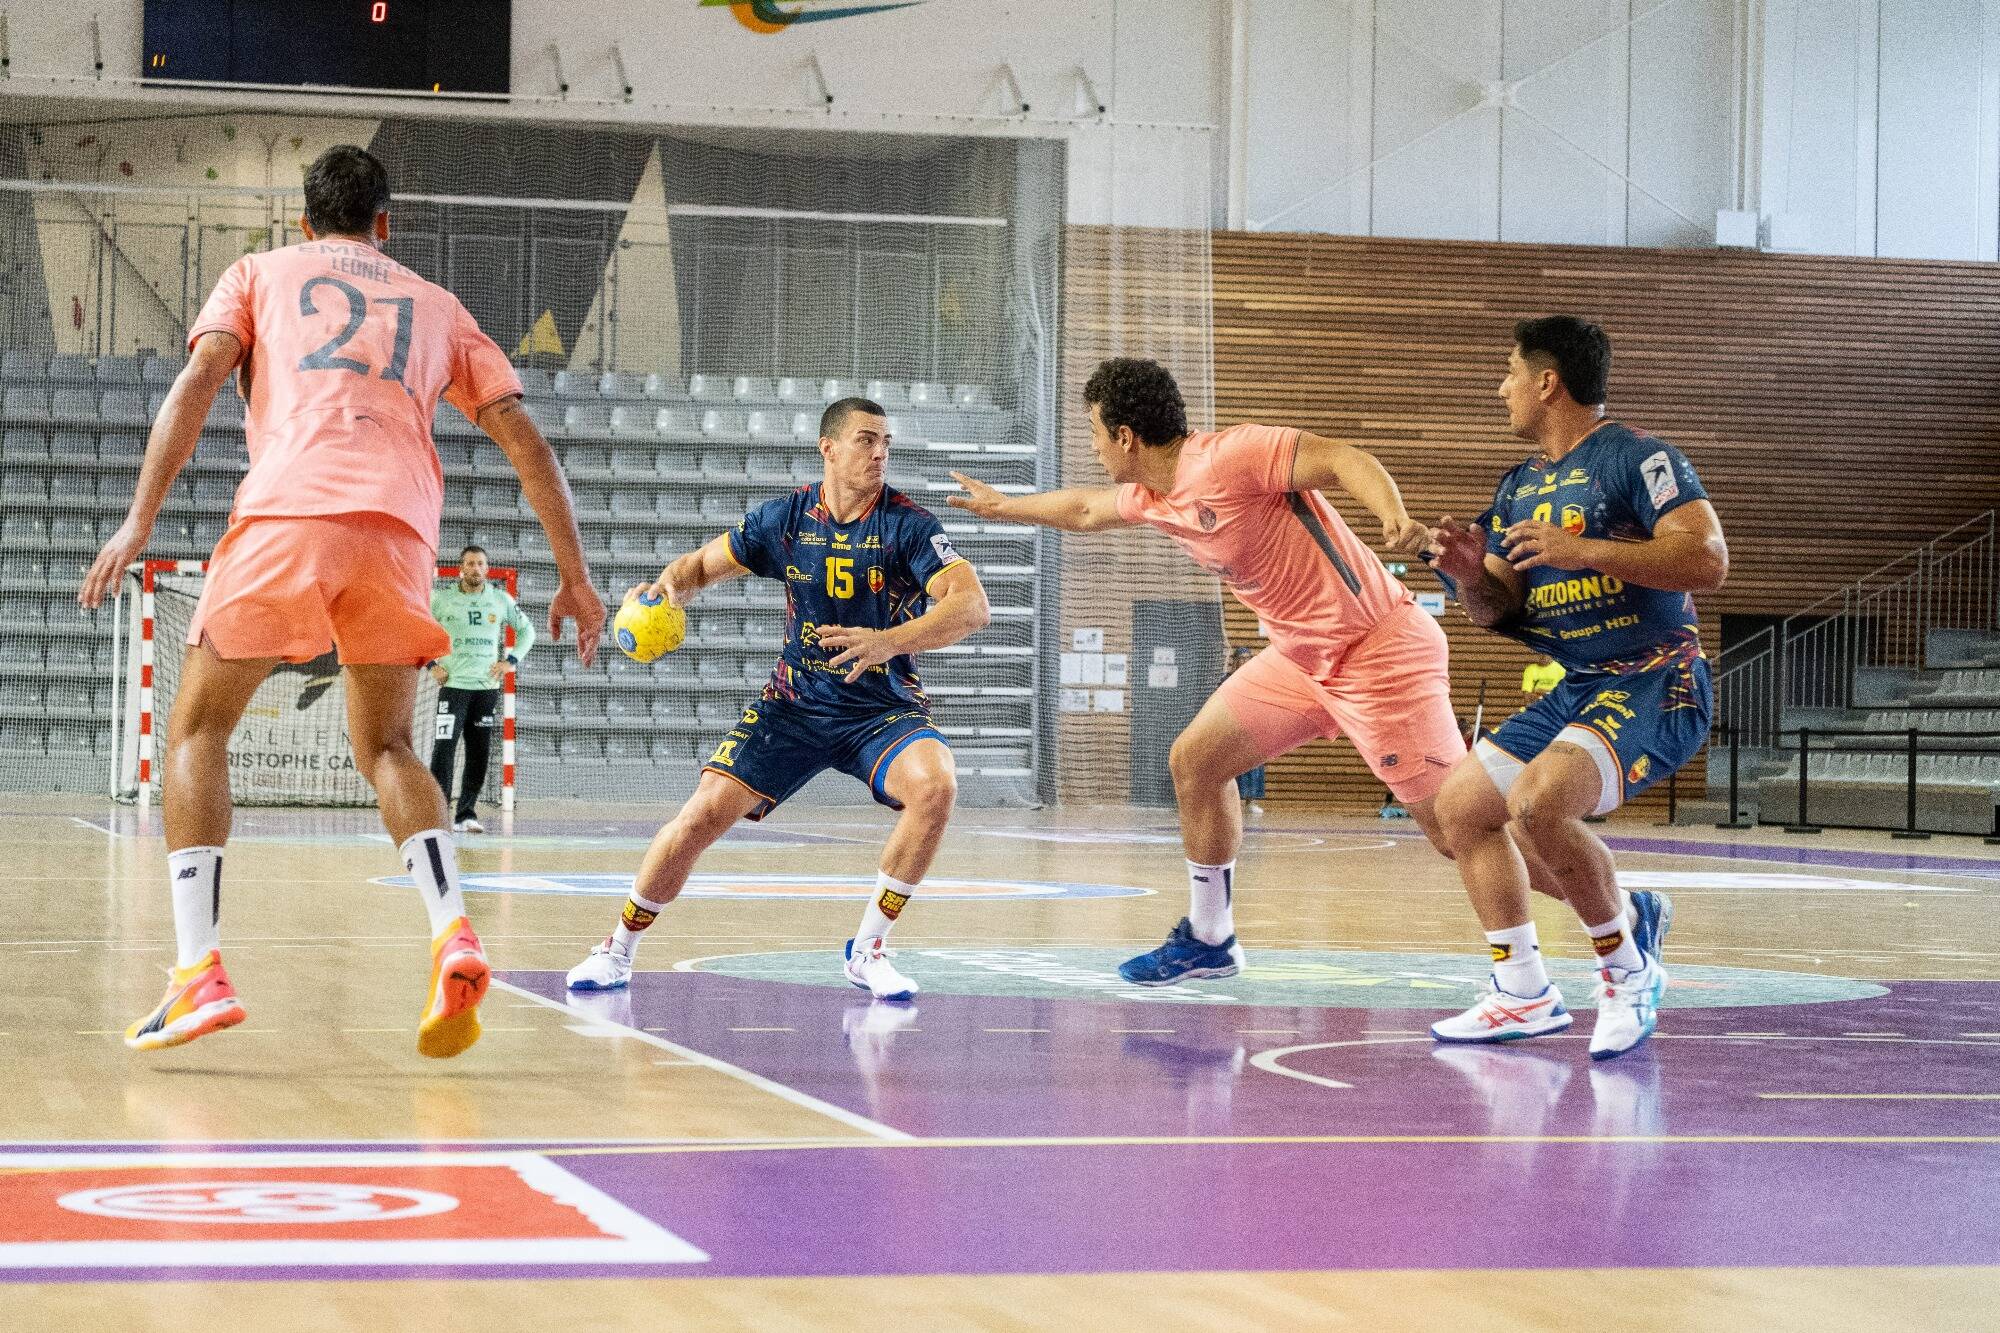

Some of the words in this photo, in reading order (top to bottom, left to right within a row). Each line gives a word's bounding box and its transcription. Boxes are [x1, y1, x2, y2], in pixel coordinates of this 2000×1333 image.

[371, 2, 386, 22] 0
[331, 256, 392, 286] LEONEL
[299, 276, 414, 380] 21
[825, 556, 855, 600] 15
[467, 611, 483, 626] 12
[1560, 624, 1602, 640] Groupe
[1605, 613, 1640, 630] HDI
[464, 636, 494, 647] PIZZORN
[240, 729, 352, 746] ALLEN
[227, 751, 320, 770] RISTOPHE
[327, 755, 354, 771] CA
